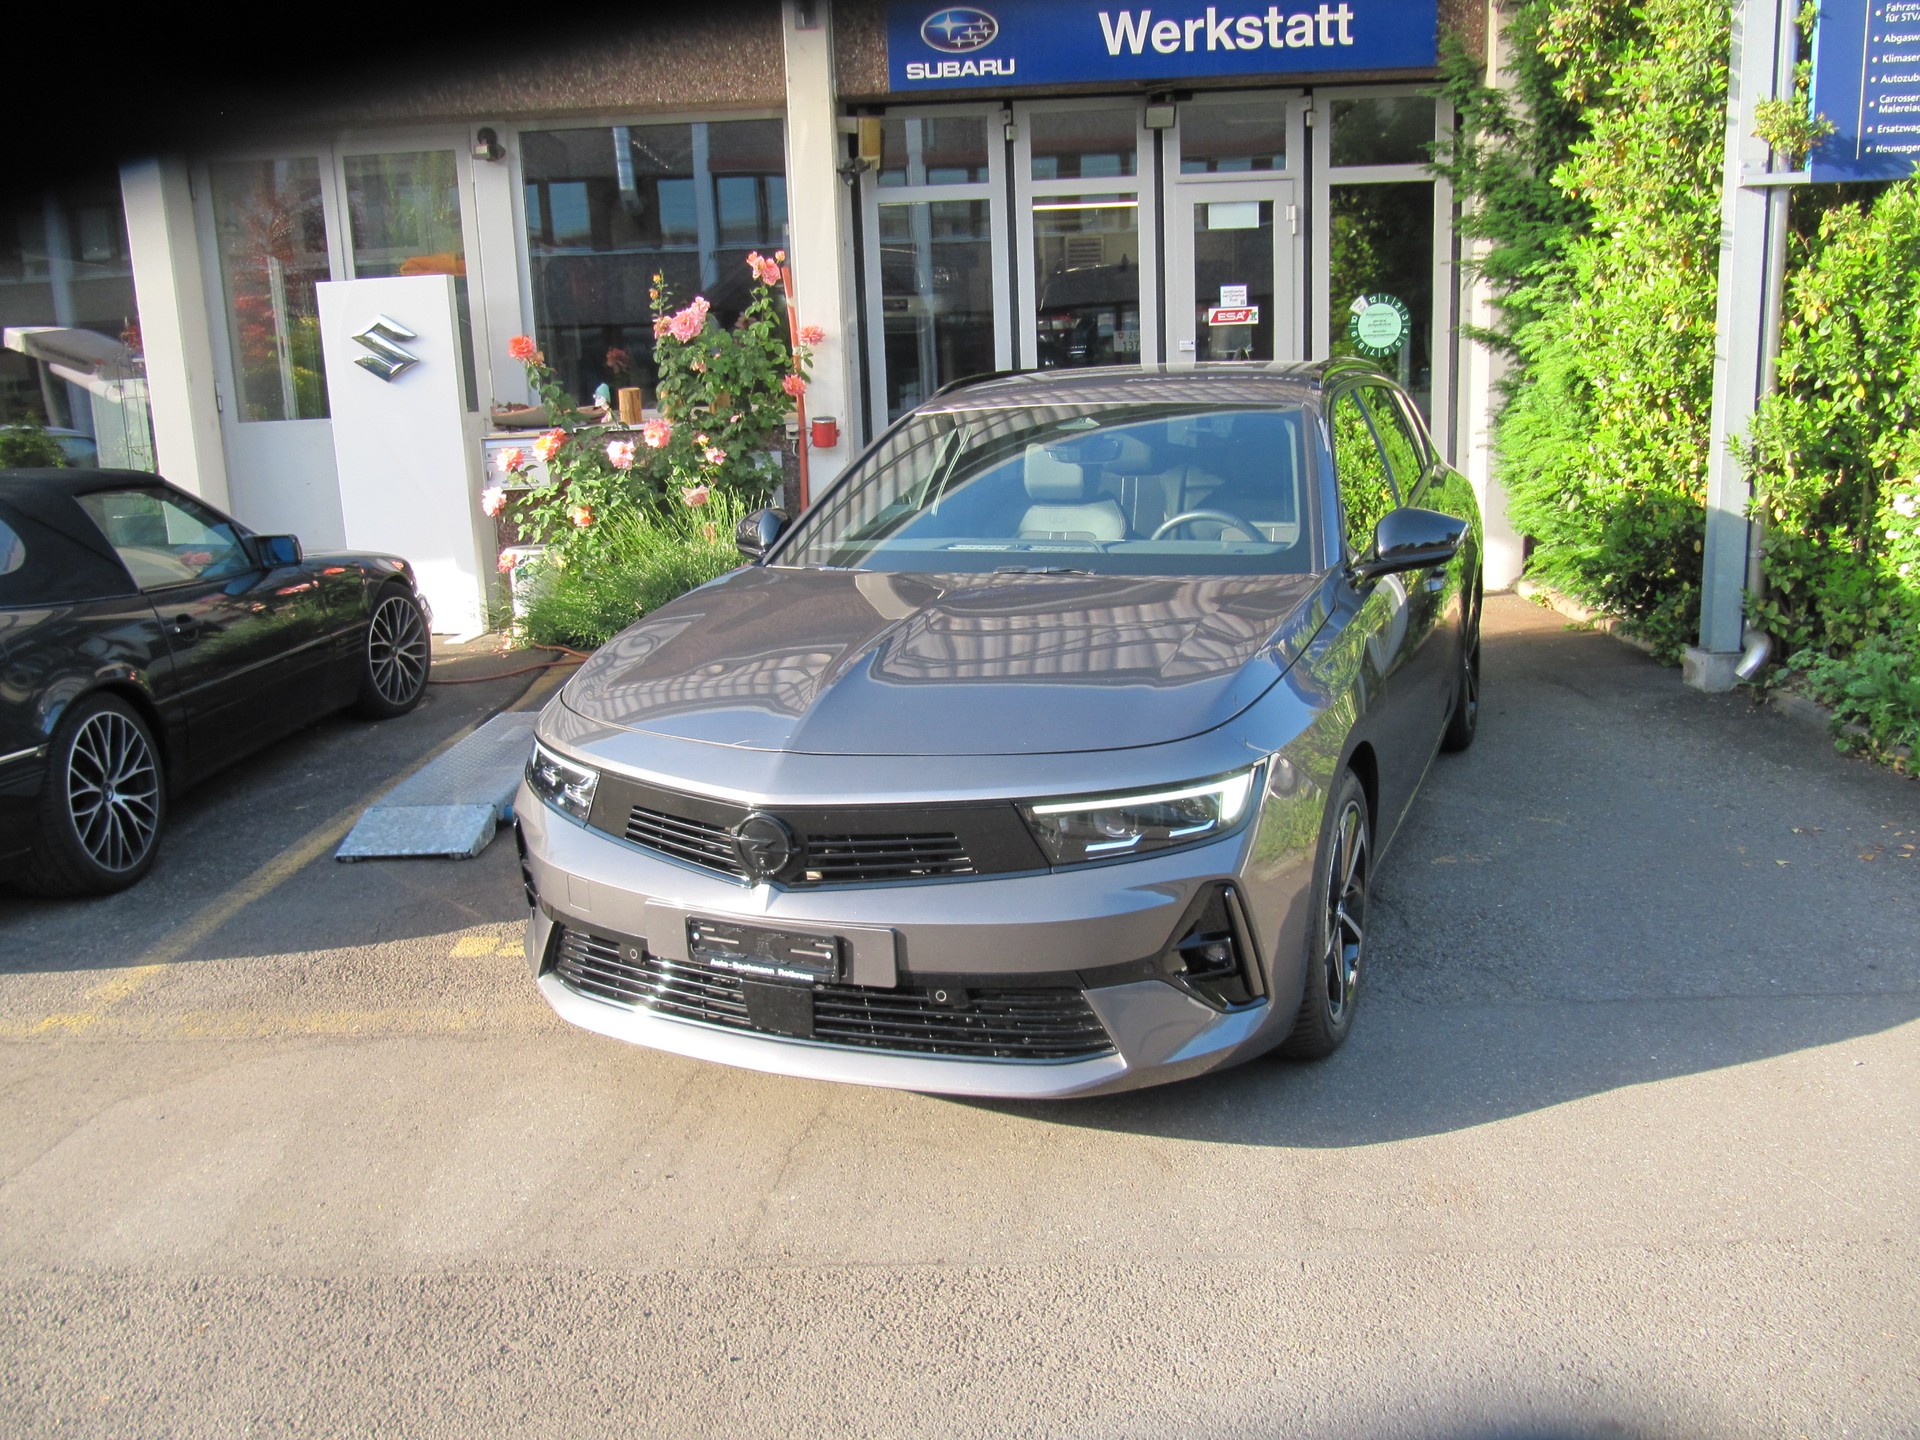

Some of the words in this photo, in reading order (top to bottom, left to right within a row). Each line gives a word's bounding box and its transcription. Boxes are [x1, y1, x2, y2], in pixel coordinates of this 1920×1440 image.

[1885, 13, 1900, 23] für
[1098, 3, 1355, 56] Werkstatt
[1882, 33, 1920, 45] Abgasw
[906, 58, 1016, 80] SUBARU
[1880, 72, 1920, 84] Autozub
[1368, 295, 1377, 304] 12
[1384, 295, 1389, 303] 1
[1394, 302, 1402, 310] 2
